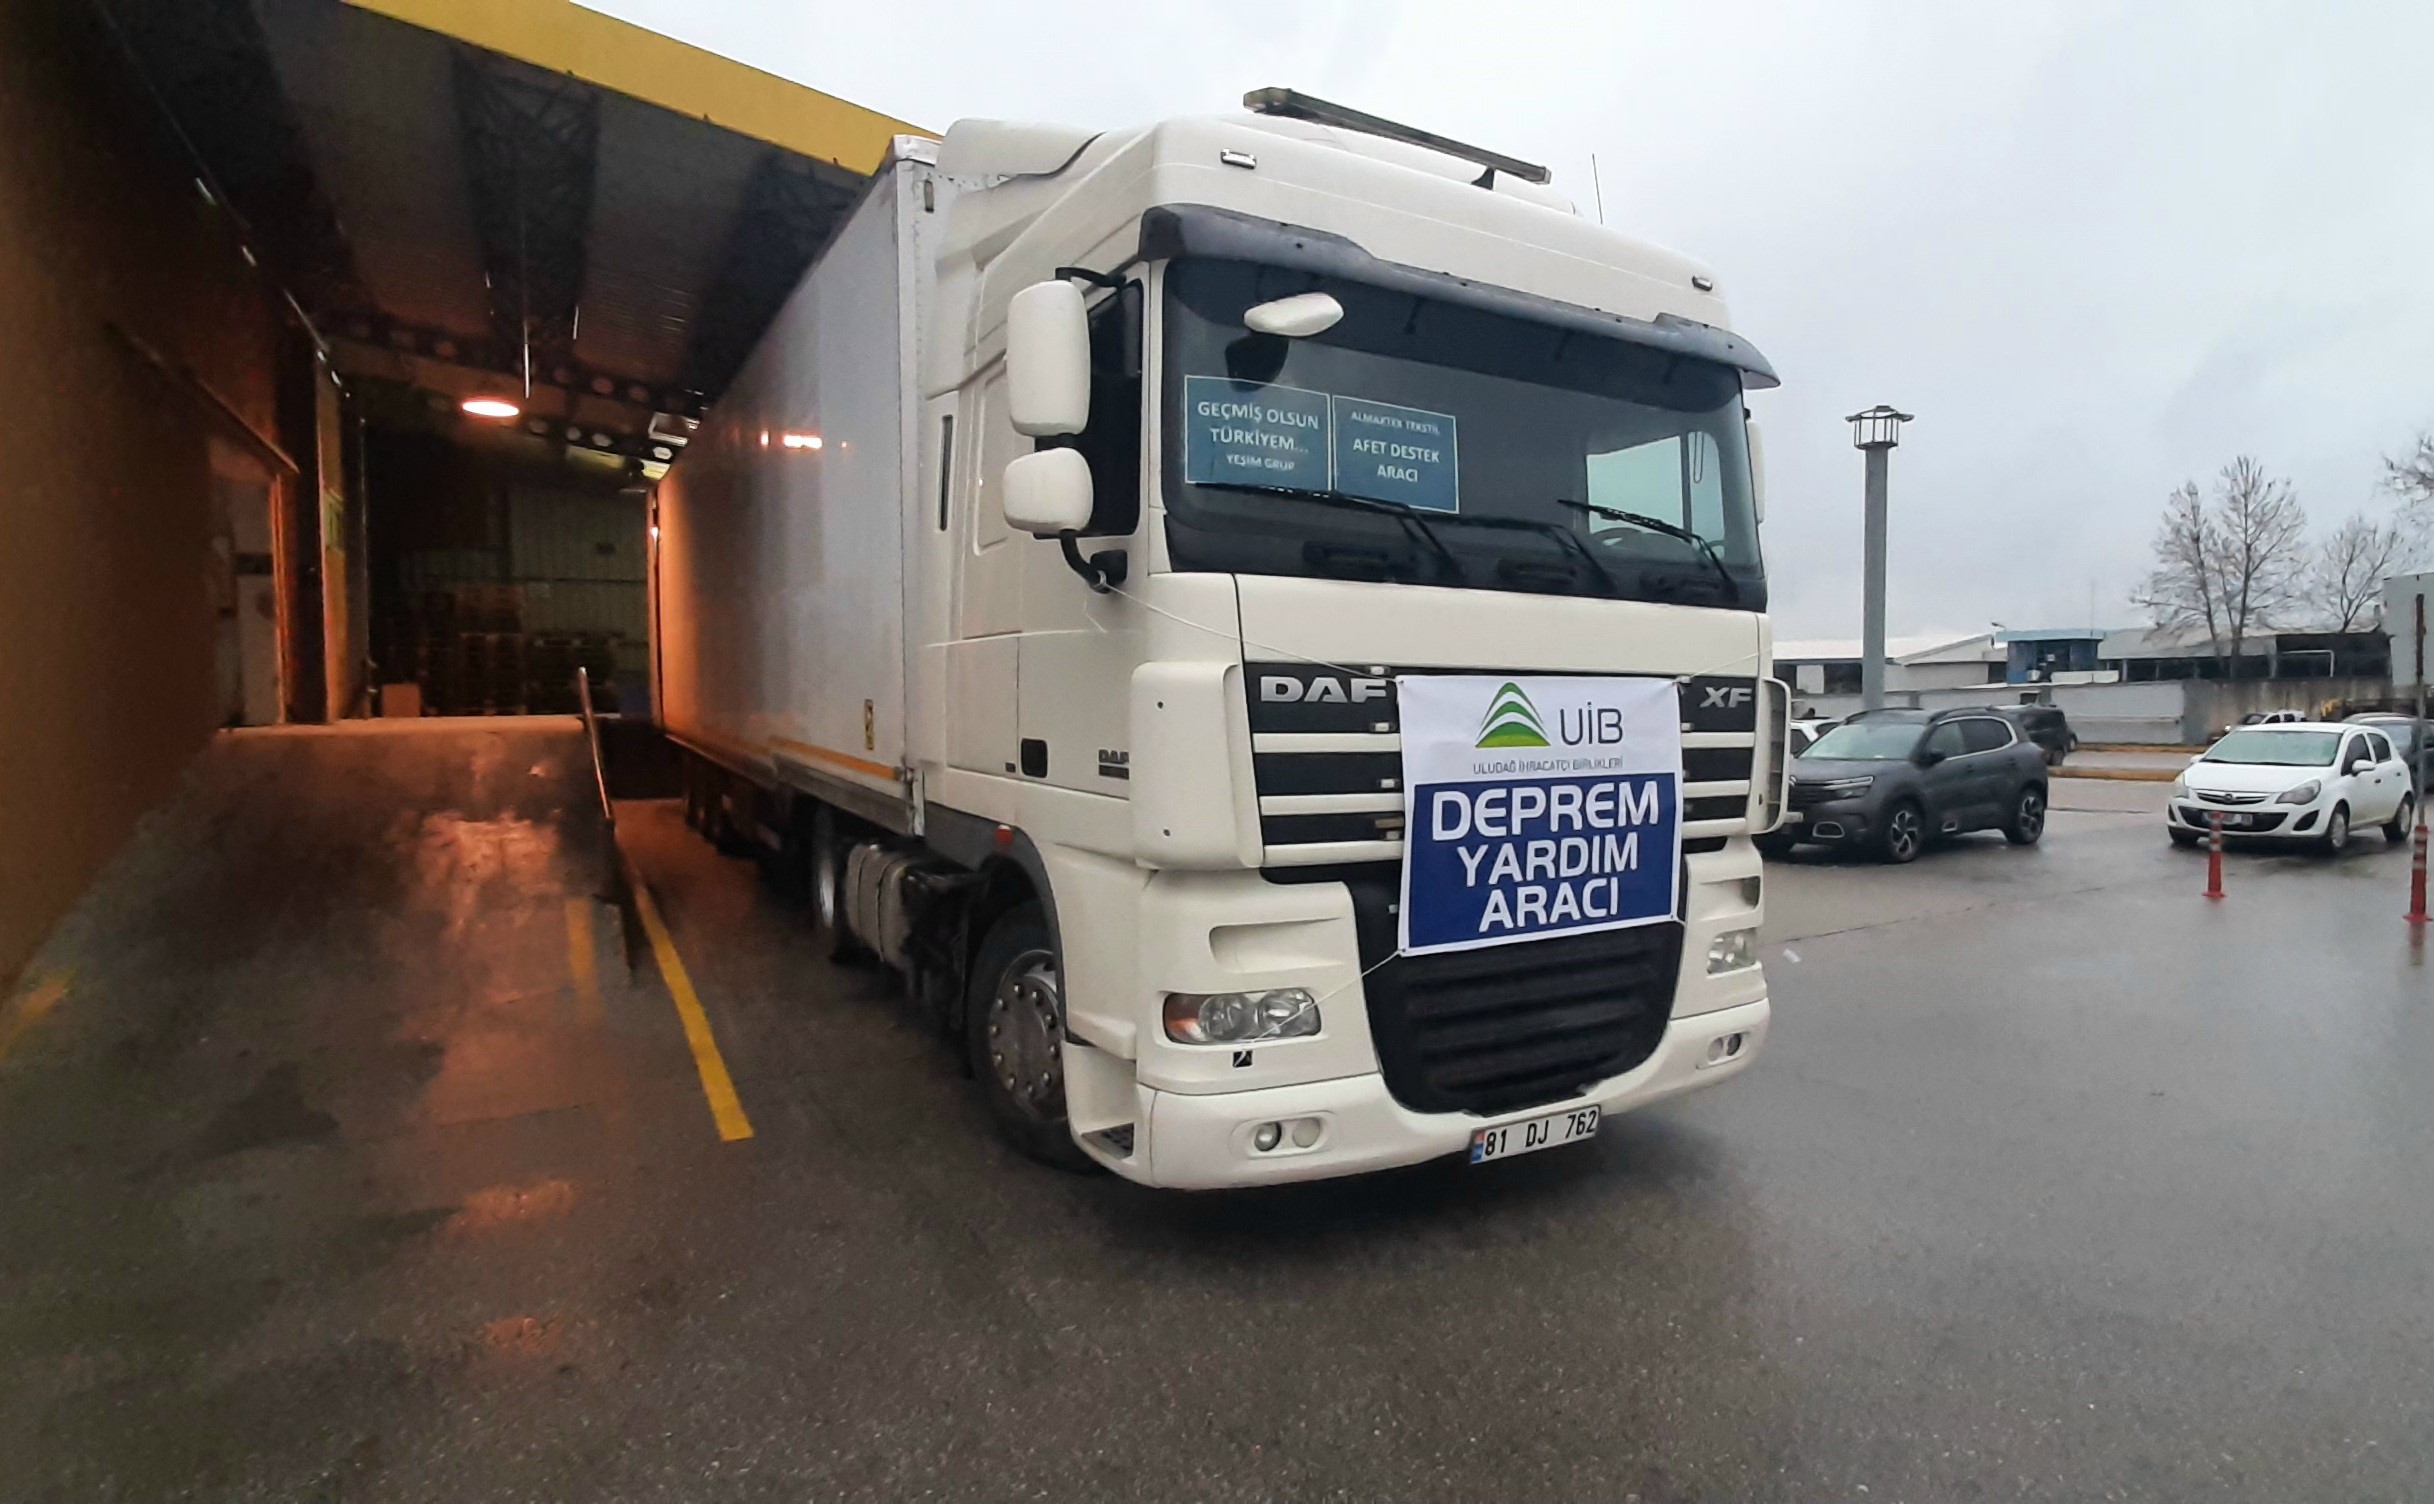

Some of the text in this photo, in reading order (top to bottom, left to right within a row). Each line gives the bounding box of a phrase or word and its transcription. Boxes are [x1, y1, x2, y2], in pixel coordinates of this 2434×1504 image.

[1197, 401, 1319, 430] GEÇMİŞ OLSUN
[1264, 458, 1296, 471] GRUP
[1353, 438, 1440, 464] AFET DESTEK
[1377, 465, 1419, 482] ARACI
[1260, 676, 1387, 703] DAF
[1700, 686, 1752, 708] XF
[1560, 701, 1623, 746] UİB
[1473, 759, 1516, 775] ULUDAĞ
[1432, 781, 1659, 841] DEPREM
[1457, 832, 1638, 887] YARDIM
[1479, 877, 1619, 933] ARACI
[1484, 1110, 1597, 1156] 81 DJ 762
